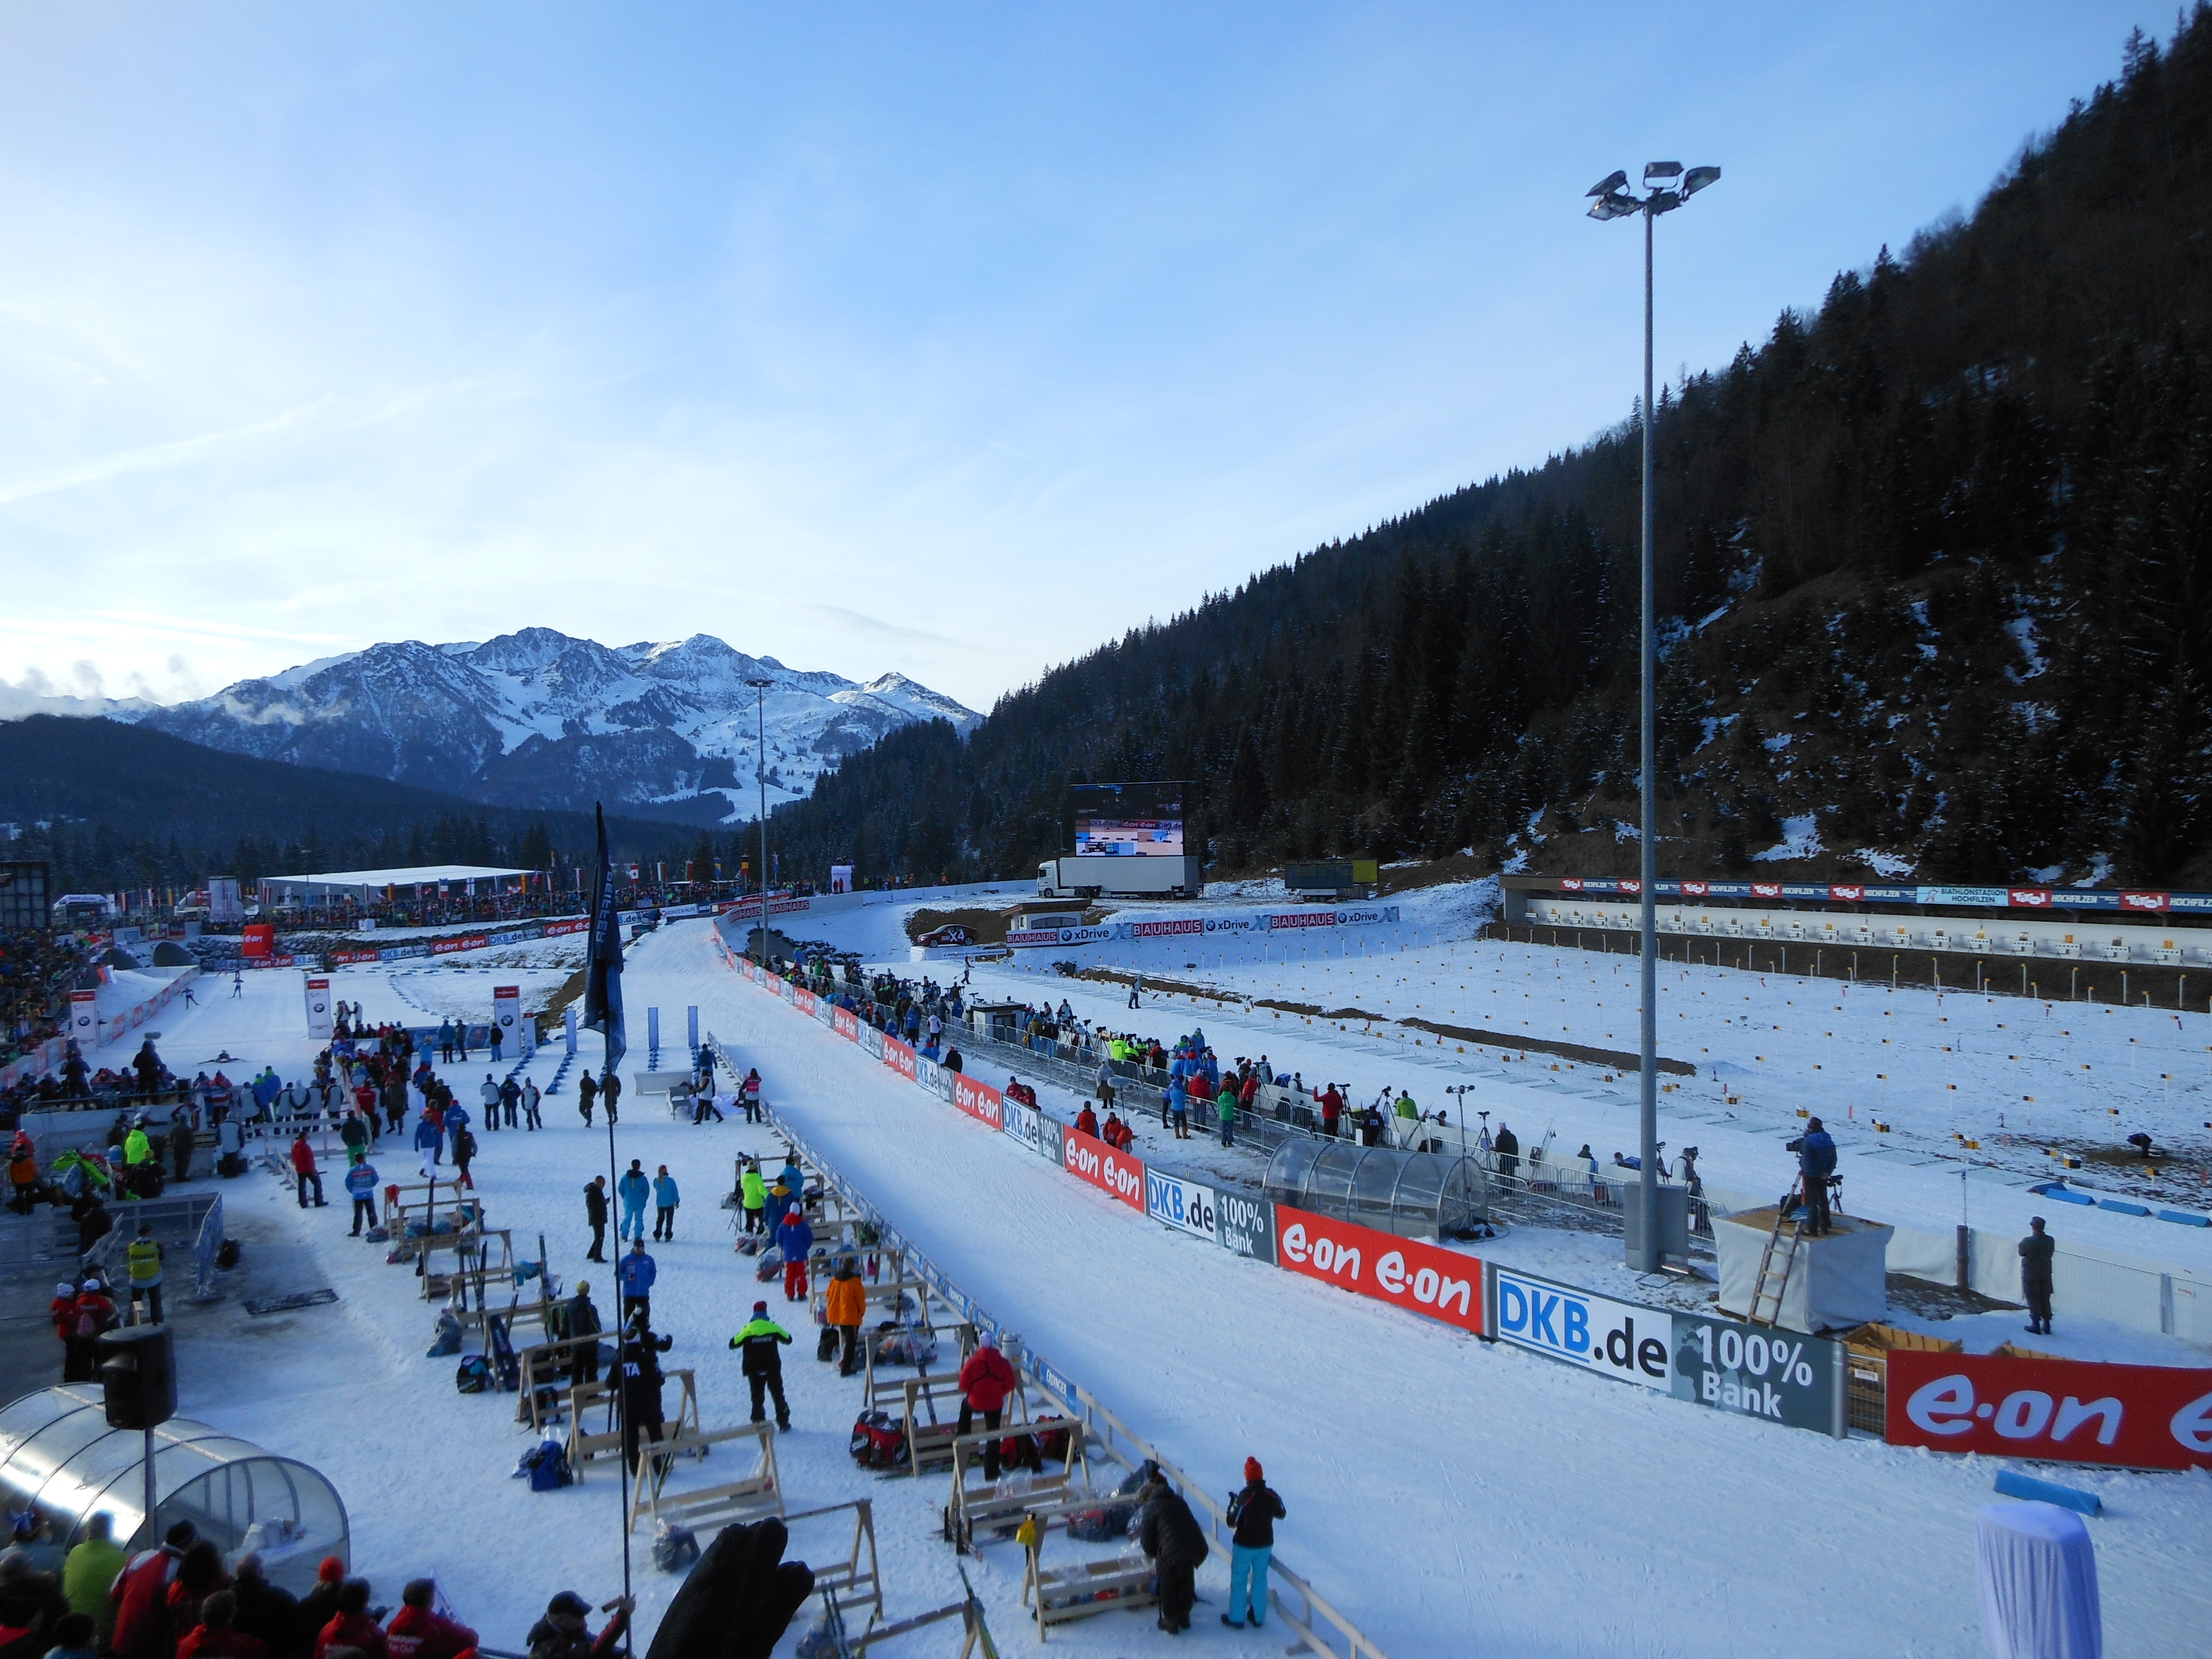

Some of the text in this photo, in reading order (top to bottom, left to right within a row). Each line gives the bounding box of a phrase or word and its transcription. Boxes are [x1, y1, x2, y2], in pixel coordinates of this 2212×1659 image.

[1863, 889, 1899, 897] HOCHFILZEN
[1941, 888, 2007, 896] BIATHLONSTADION
[2051, 894, 2098, 903] HOCHFILZEN
[769, 901, 809, 914] BAUHAUS
[618, 914, 637, 924] B.de
[1272, 913, 1334, 927] BAUHAUS
[1349, 912, 1378, 922] xDrive
[1134, 920, 1201, 936] BAUHAUS
[1218, 920, 1249, 930] xDrive
[491, 932, 523, 944] DKB.de
[949, 929, 965, 942] X4
[1007, 932, 1056, 944] BAUHAUS
[1074, 929, 1109, 939] xDrive
[381, 947, 412, 959] DKB.de
[916, 1058, 938, 1092] DKB.de
[1005, 1101, 1038, 1145] DKB.de
[1040, 1117, 1060, 1145] 100%
[1042, 1139, 1056, 1161] Bank
[1149, 1177, 1214, 1233] DKB.de
[1221, 1194, 1264, 1234] 100%
[1225, 1226, 1254, 1255] Bank
[1500, 1280, 1668, 1379] DKB.de
[1695, 1324, 1813, 1387] 100%
[1046, 1367, 1068, 1398] ERDINGER
[1702, 1370, 1783, 1419] Bank
